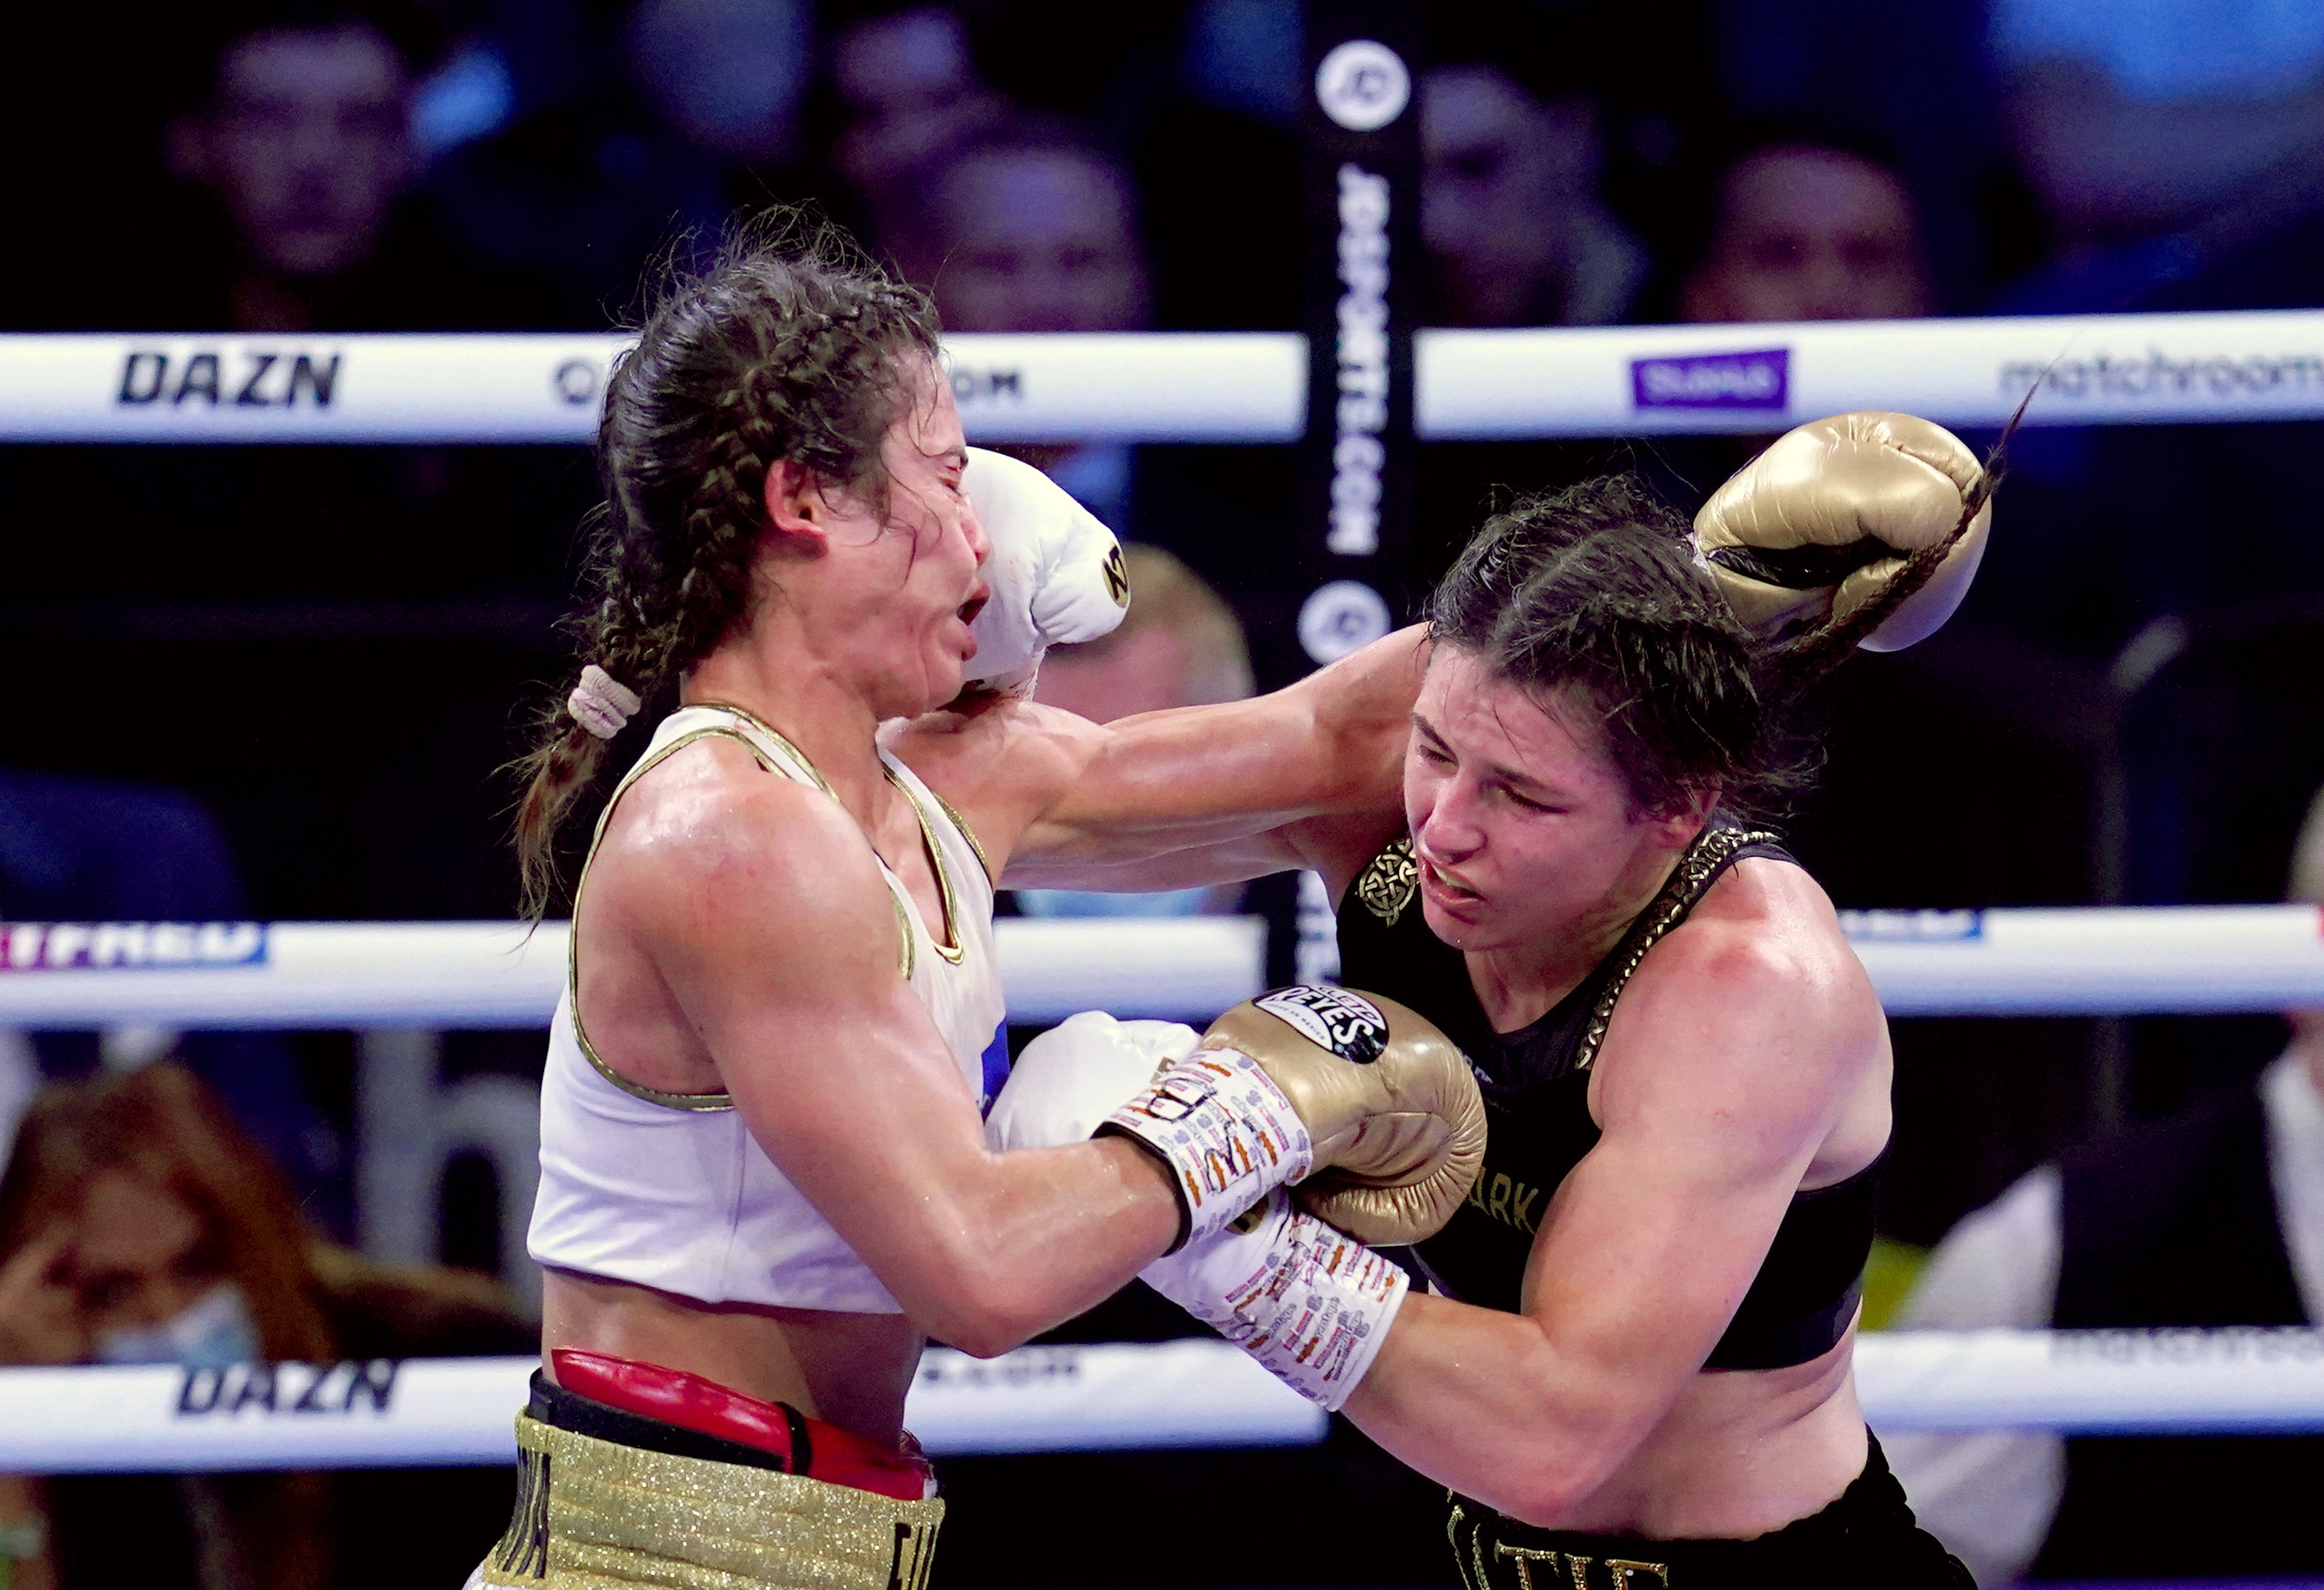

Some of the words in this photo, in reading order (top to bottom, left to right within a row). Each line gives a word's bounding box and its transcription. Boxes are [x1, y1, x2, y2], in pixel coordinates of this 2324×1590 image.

[117, 351, 341, 407] DAZN
[1259, 985, 1375, 1046] REYES
[175, 1362, 400, 1419] DAZN
